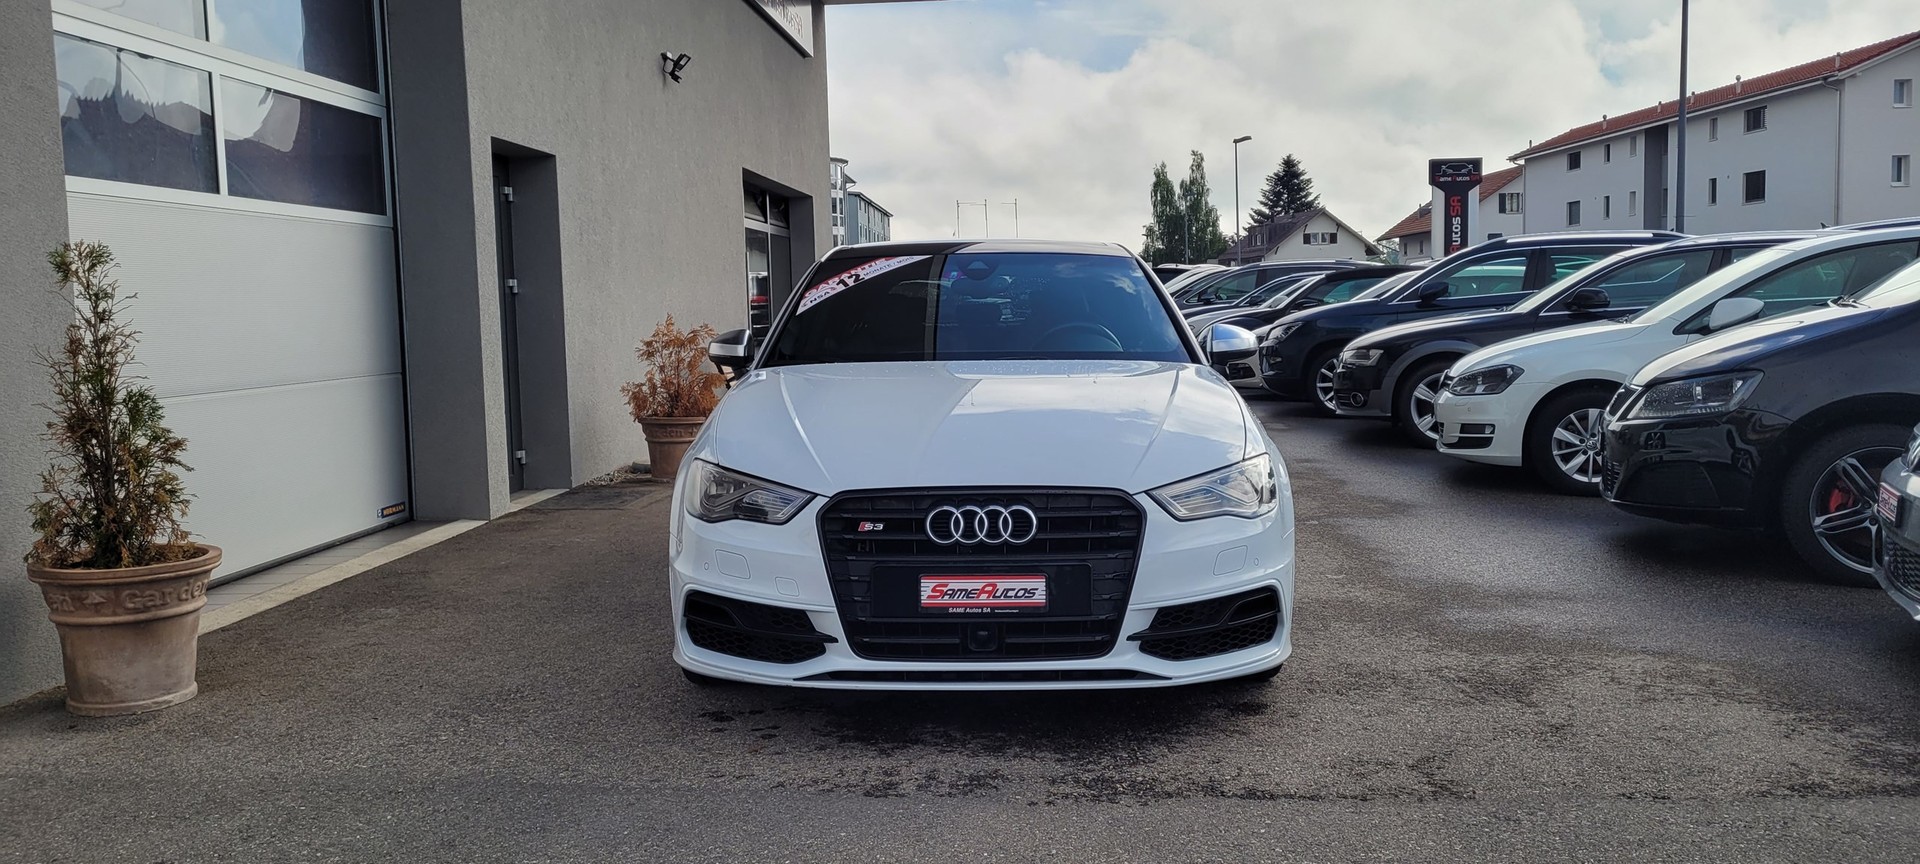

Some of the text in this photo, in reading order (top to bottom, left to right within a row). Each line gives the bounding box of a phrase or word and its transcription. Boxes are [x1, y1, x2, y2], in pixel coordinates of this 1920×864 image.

[1450, 196, 1461, 216] SA
[836, 273, 865, 288] 12
[863, 523, 884, 531] S3
